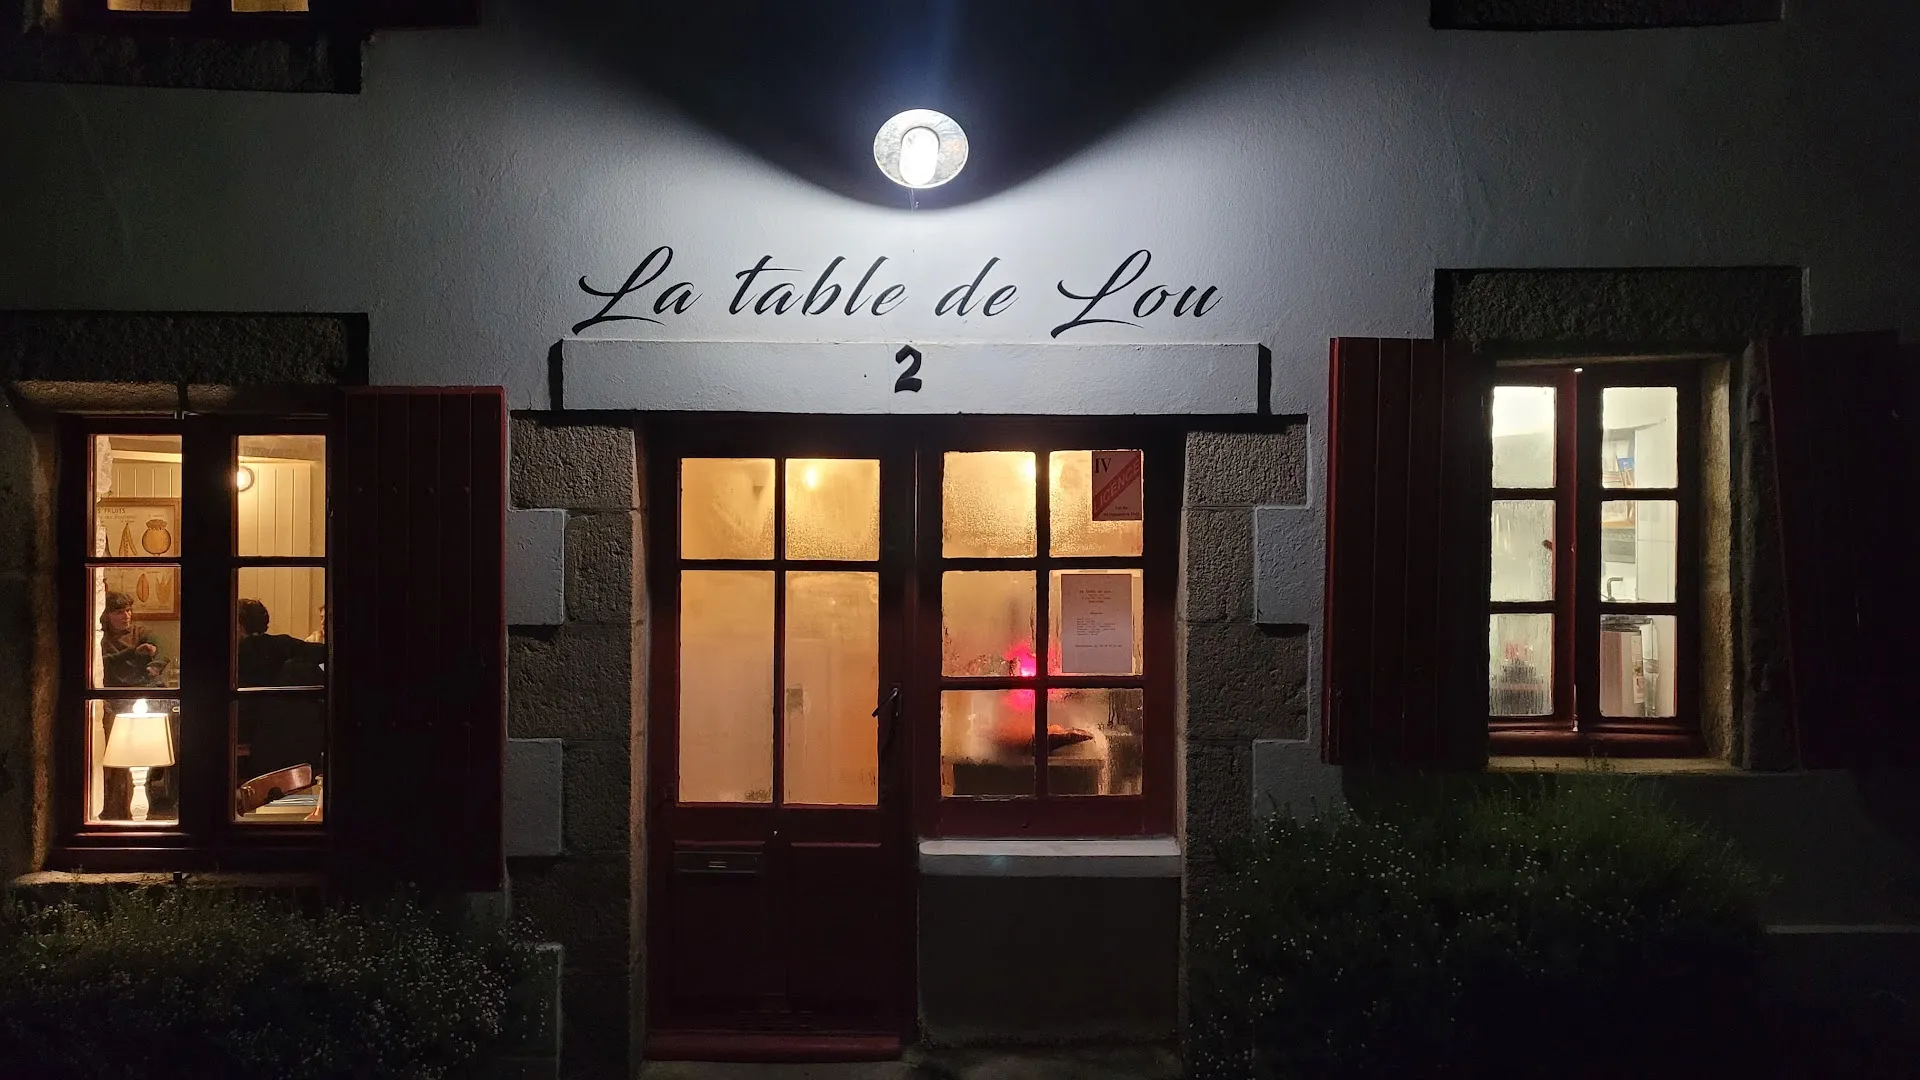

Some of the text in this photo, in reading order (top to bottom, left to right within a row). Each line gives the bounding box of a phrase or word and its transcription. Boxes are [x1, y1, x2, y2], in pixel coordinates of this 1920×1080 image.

[571, 245, 1224, 338] La table de Lou
[894, 344, 922, 393] 2
[1094, 457, 1112, 474] IV
[1094, 457, 1141, 514] LICENCE
